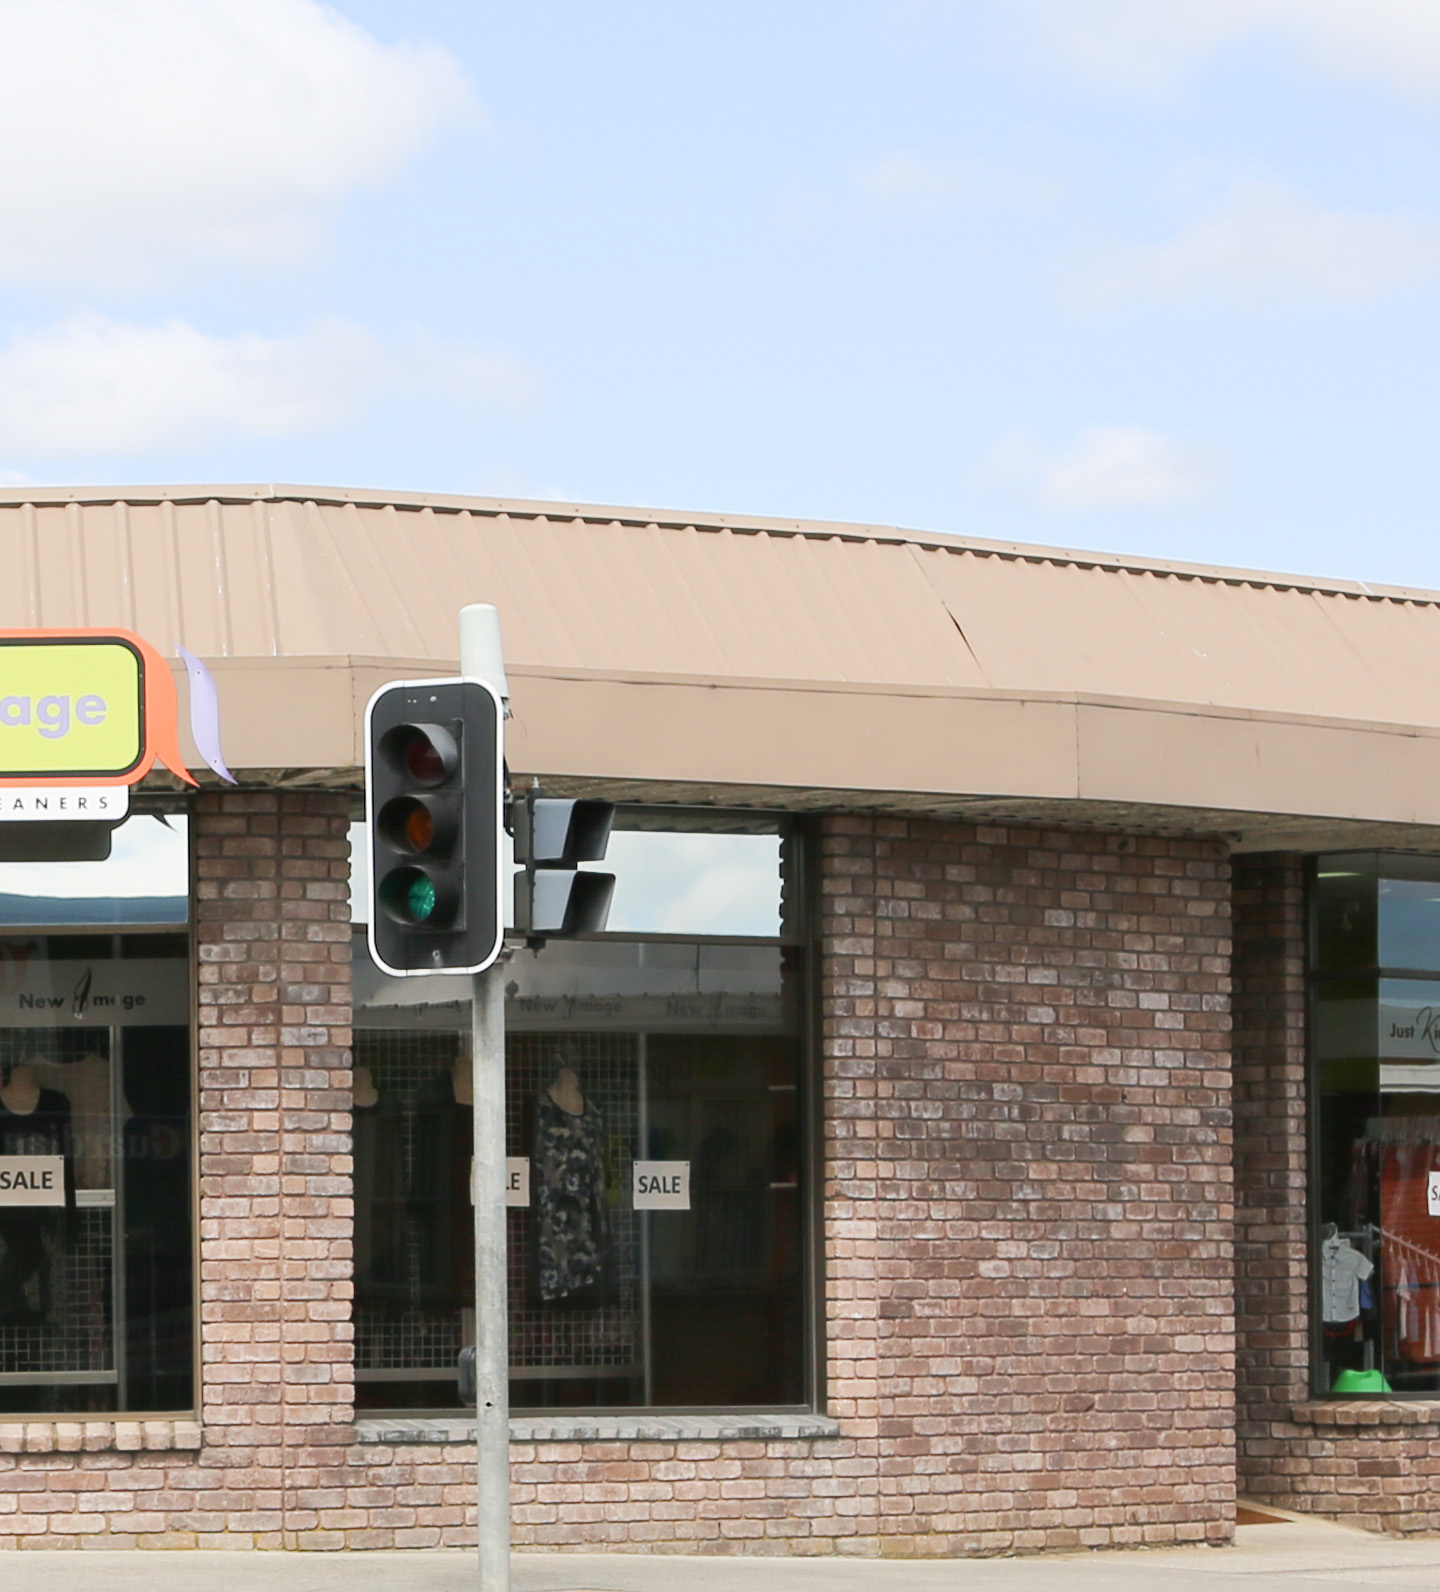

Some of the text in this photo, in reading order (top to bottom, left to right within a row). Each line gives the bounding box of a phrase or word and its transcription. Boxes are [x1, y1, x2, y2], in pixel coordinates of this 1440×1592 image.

[19, 993, 65, 1010] New
[1390, 1023, 1415, 1039] Just
[638, 1175, 681, 1194] SALE
